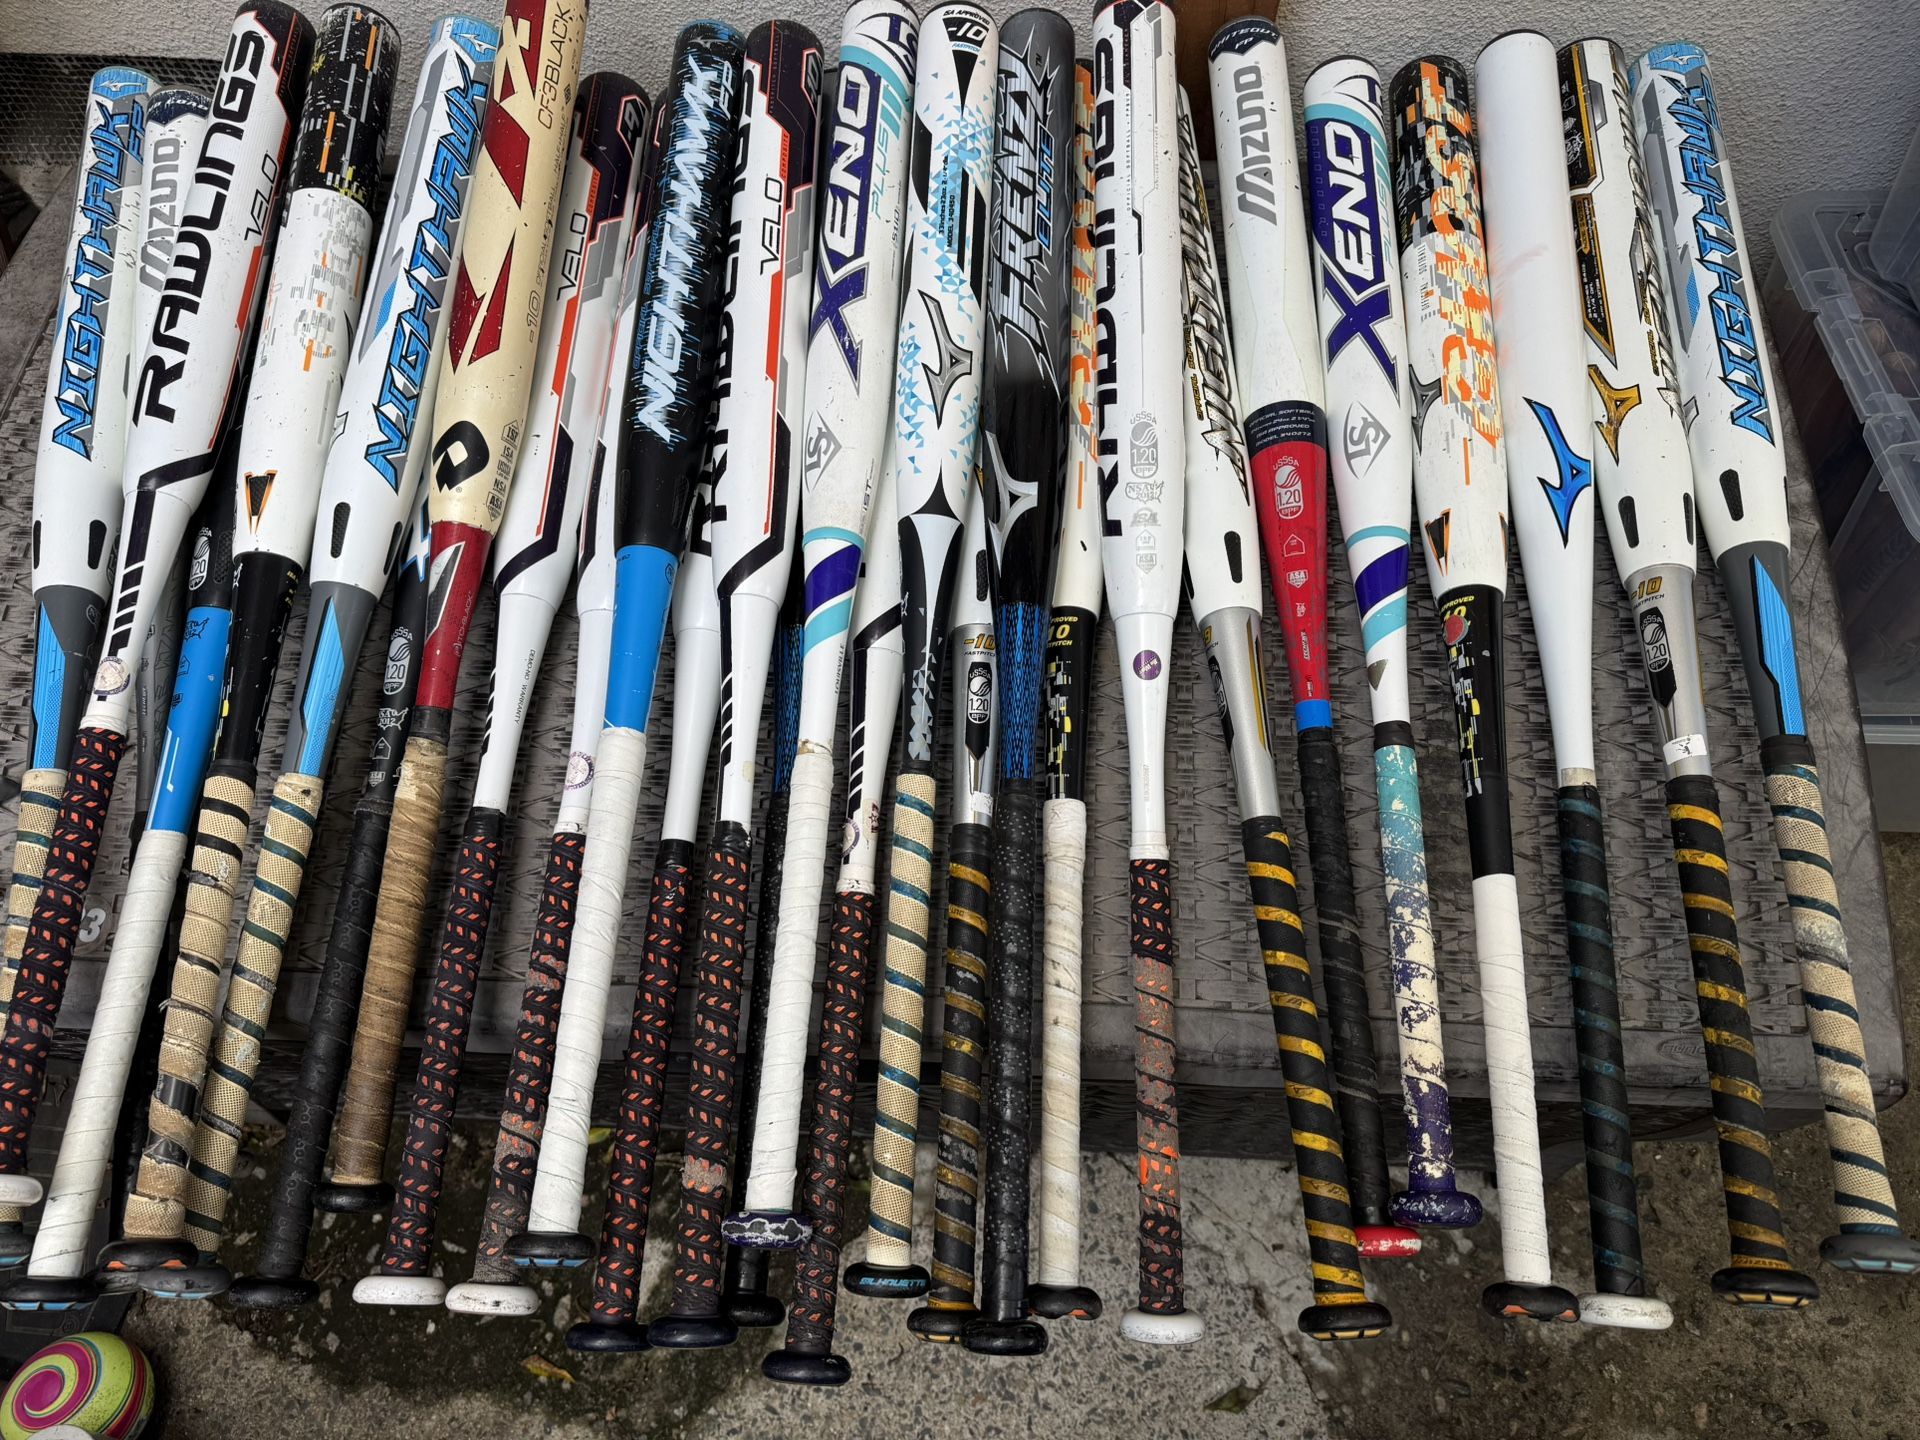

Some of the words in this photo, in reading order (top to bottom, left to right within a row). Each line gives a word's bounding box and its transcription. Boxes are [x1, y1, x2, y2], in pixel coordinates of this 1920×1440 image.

[947, 22, 988, 40] -10
[957, 9, 990, 26] APPROVED
[952, 42, 980, 52] FASTPITCH
[1211, 27, 1278, 56] WHITEOUT
[1235, 37, 1254, 50] FP
[537, 5, 571, 130] CF3BLACK
[718, 60, 734, 120] FP
[780, 133, 790, 178] COMPOSITE
[1234, 65, 1277, 226] MIZUNO
[870, 126, 890, 220] PLUS
[1036, 123, 1054, 252] ELITE
[139, 137, 181, 292] MIZUNO
[244, 153, 279, 241] VELO
[999, 48, 1045, 348] FRENZY
[133, 30, 265, 427] RAWLINGS
[637, 54, 718, 443] NIGHTHAWK
[760, 177, 783, 275] VELO
[808, 63, 871, 398] XENO
[946, 223, 955, 247] MODEL
[1377, 185, 1394, 269] PLUS
[365, 50, 489, 496] NIGHTHAWK
[557, 212, 588, 300] VELO
[1324, 121, 1400, 407] XENO
[1661, 75, 1776, 448] NIGHTHAWK
[53, 100, 128, 460] NIGHTHAWK
[1130, 411, 1157, 425] USSSA
[1193, 374, 1205, 421] OFFICIAL
[1256, 435, 1278, 447] MODEL
[1268, 424, 1310, 434] APPROVED
[1132, 447, 1157, 464] 1.20
[1273, 455, 1300, 471] USSSA
[1276, 488, 1302, 507] 1.20
[1290, 570, 1306, 581] ASA
[1631, 577, 1662, 600] -10
[1641, 615, 1663, 631] USSSA
[834, 642, 847, 695] LOUISVILLE
[969, 667, 992, 680] USSSA
[515, 684, 529, 725] WARRANTY
[968, 698, 990, 713] 1.20
